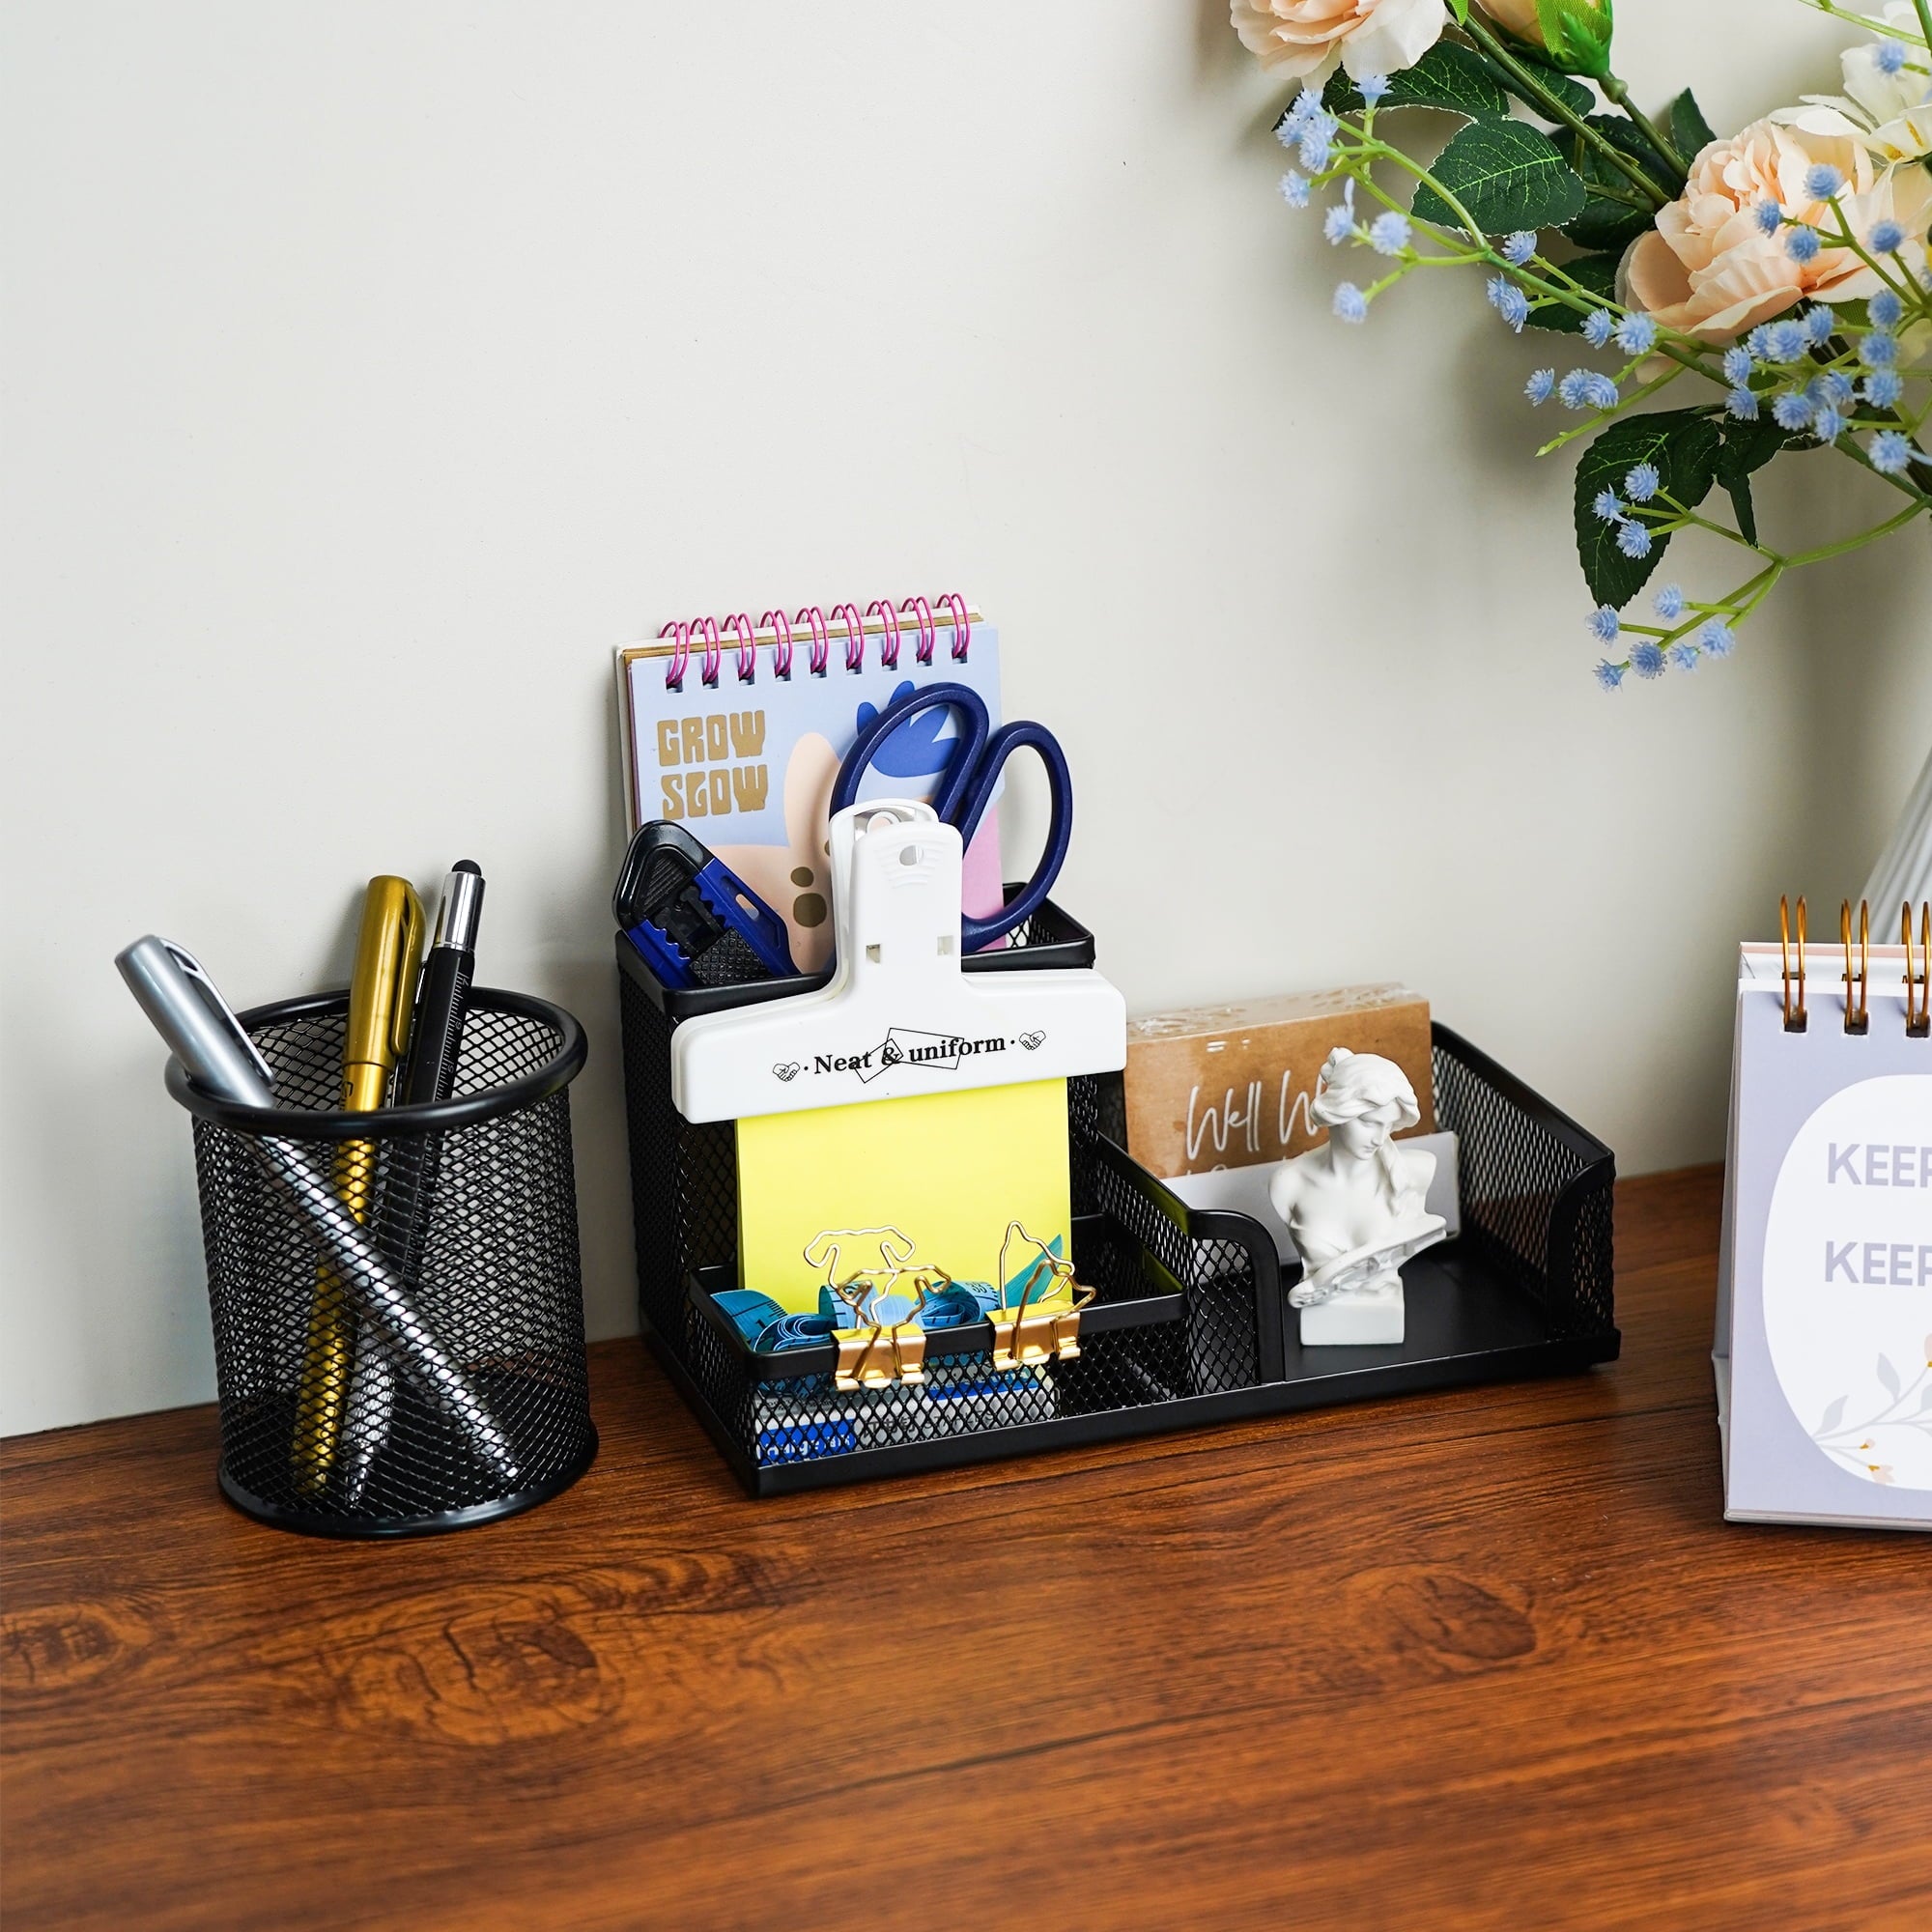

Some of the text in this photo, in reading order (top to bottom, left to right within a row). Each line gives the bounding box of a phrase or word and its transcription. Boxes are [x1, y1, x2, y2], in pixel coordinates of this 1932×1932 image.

[657, 709, 766, 767] GROW
[661, 763, 768, 820] SLOW
[814, 1037, 1007, 1074] Neat & uniform
[1186, 1080, 1263, 1160] Well
